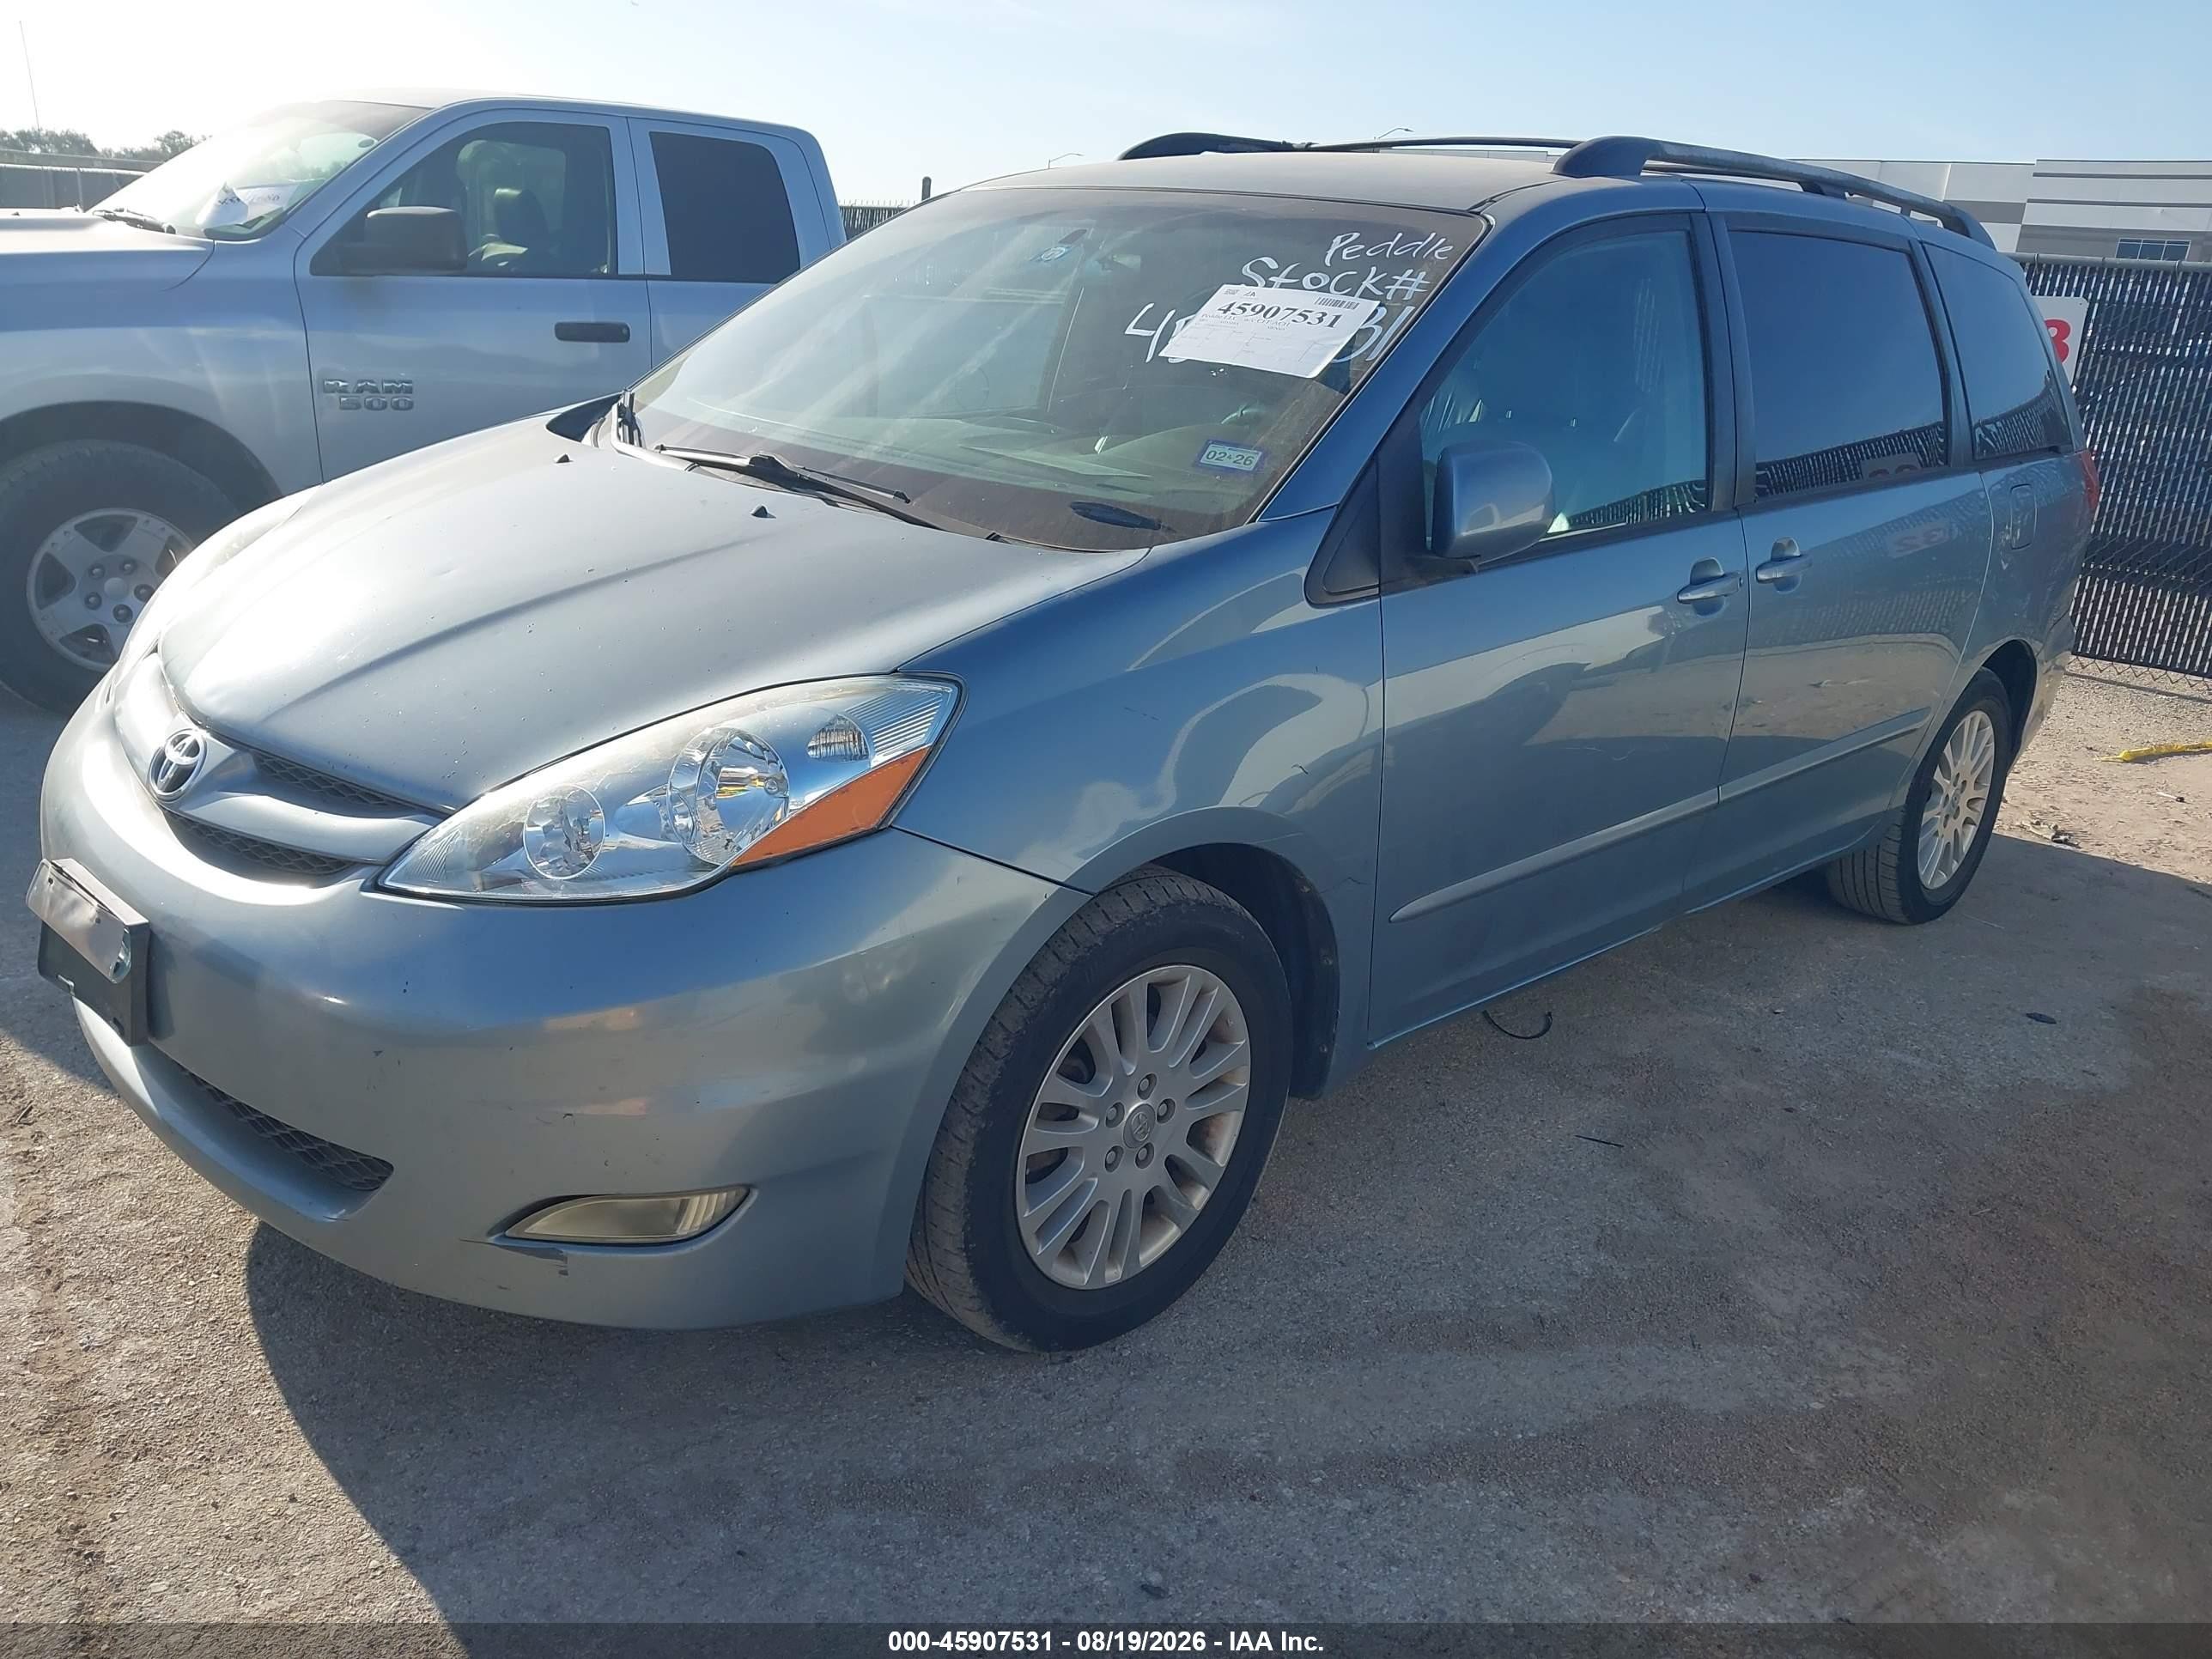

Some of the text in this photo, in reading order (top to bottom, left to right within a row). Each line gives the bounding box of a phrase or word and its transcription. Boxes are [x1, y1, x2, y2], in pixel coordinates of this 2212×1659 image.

[1324, 232, 1453, 266] Peddle
[1217, 301, 1342, 328] 45907531
[323, 379, 413, 394] RAM
[339, 396, 414, 410] 500
